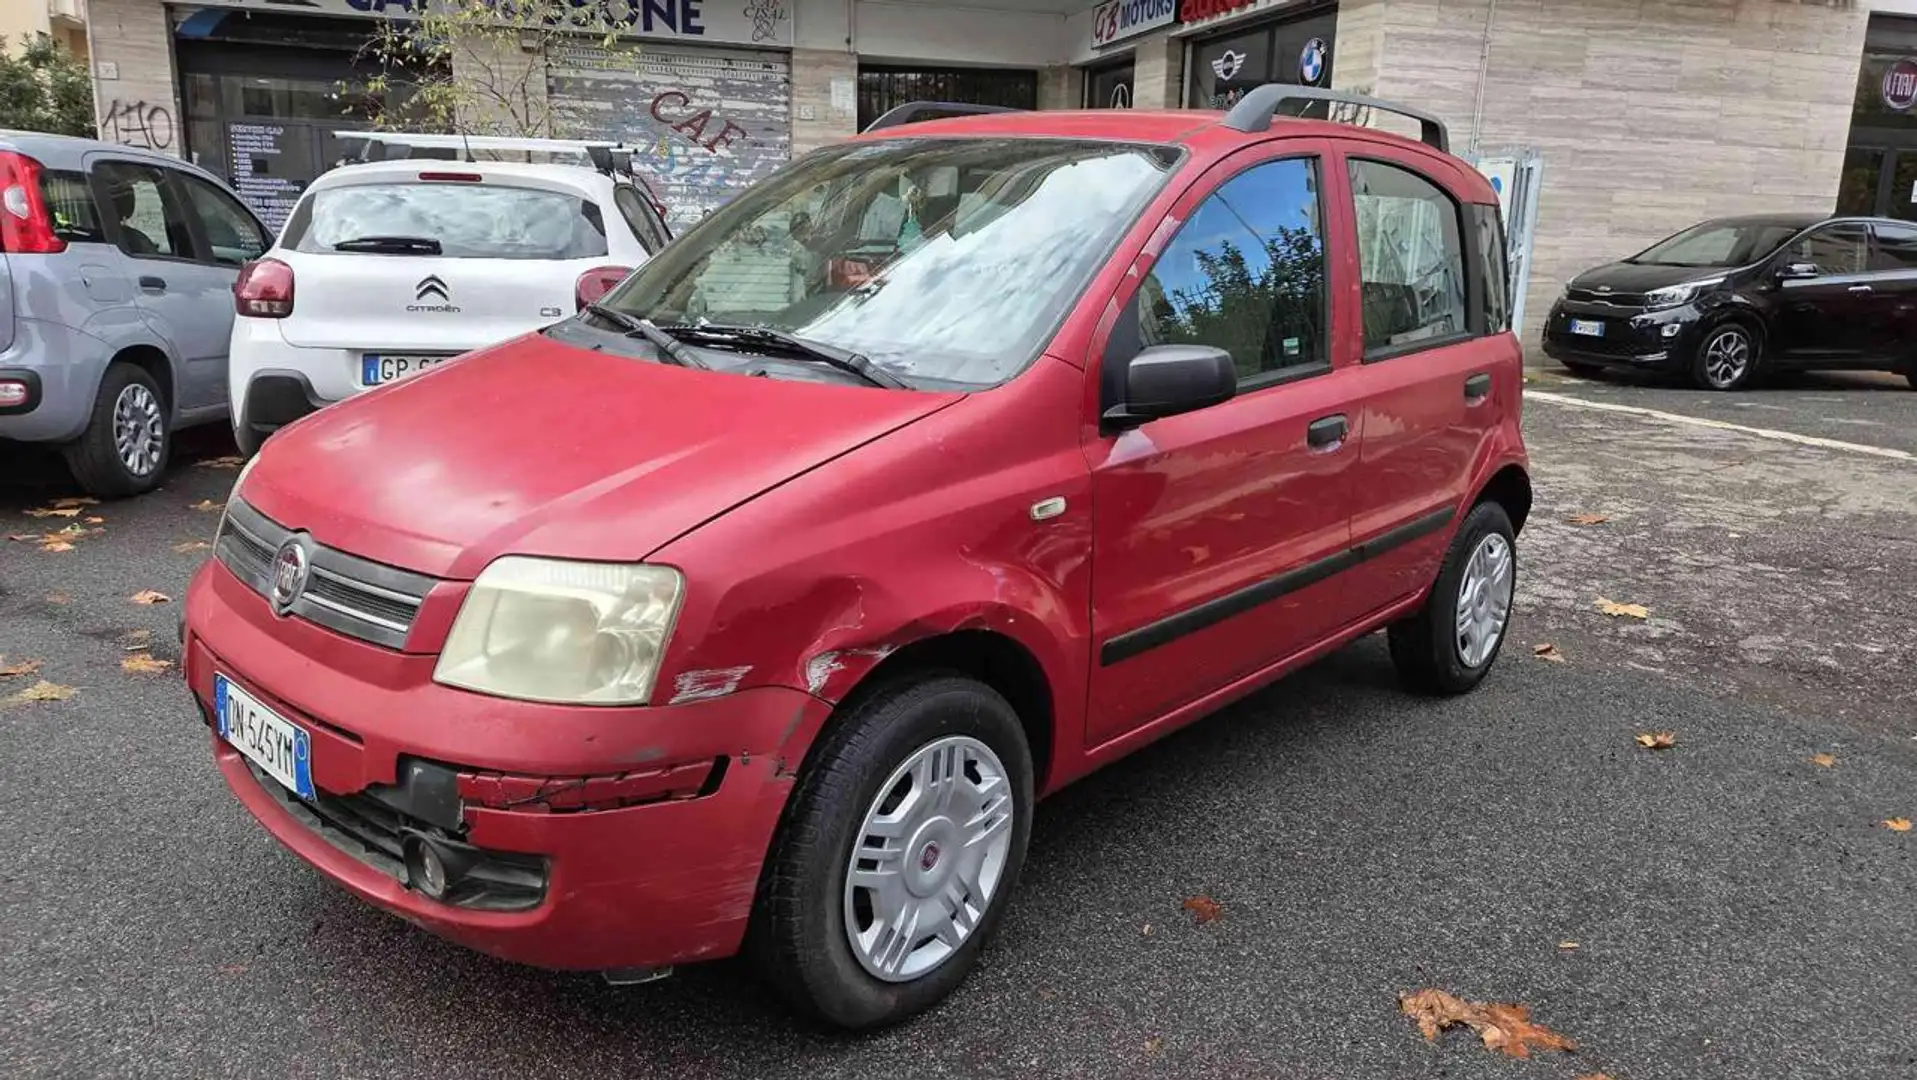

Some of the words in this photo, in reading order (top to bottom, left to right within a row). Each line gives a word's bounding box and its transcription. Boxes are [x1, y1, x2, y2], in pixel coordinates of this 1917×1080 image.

[1120, 0, 1173, 30] MOTORS
[651, 91, 747, 153] CAF
[540, 308, 562, 317] C3
